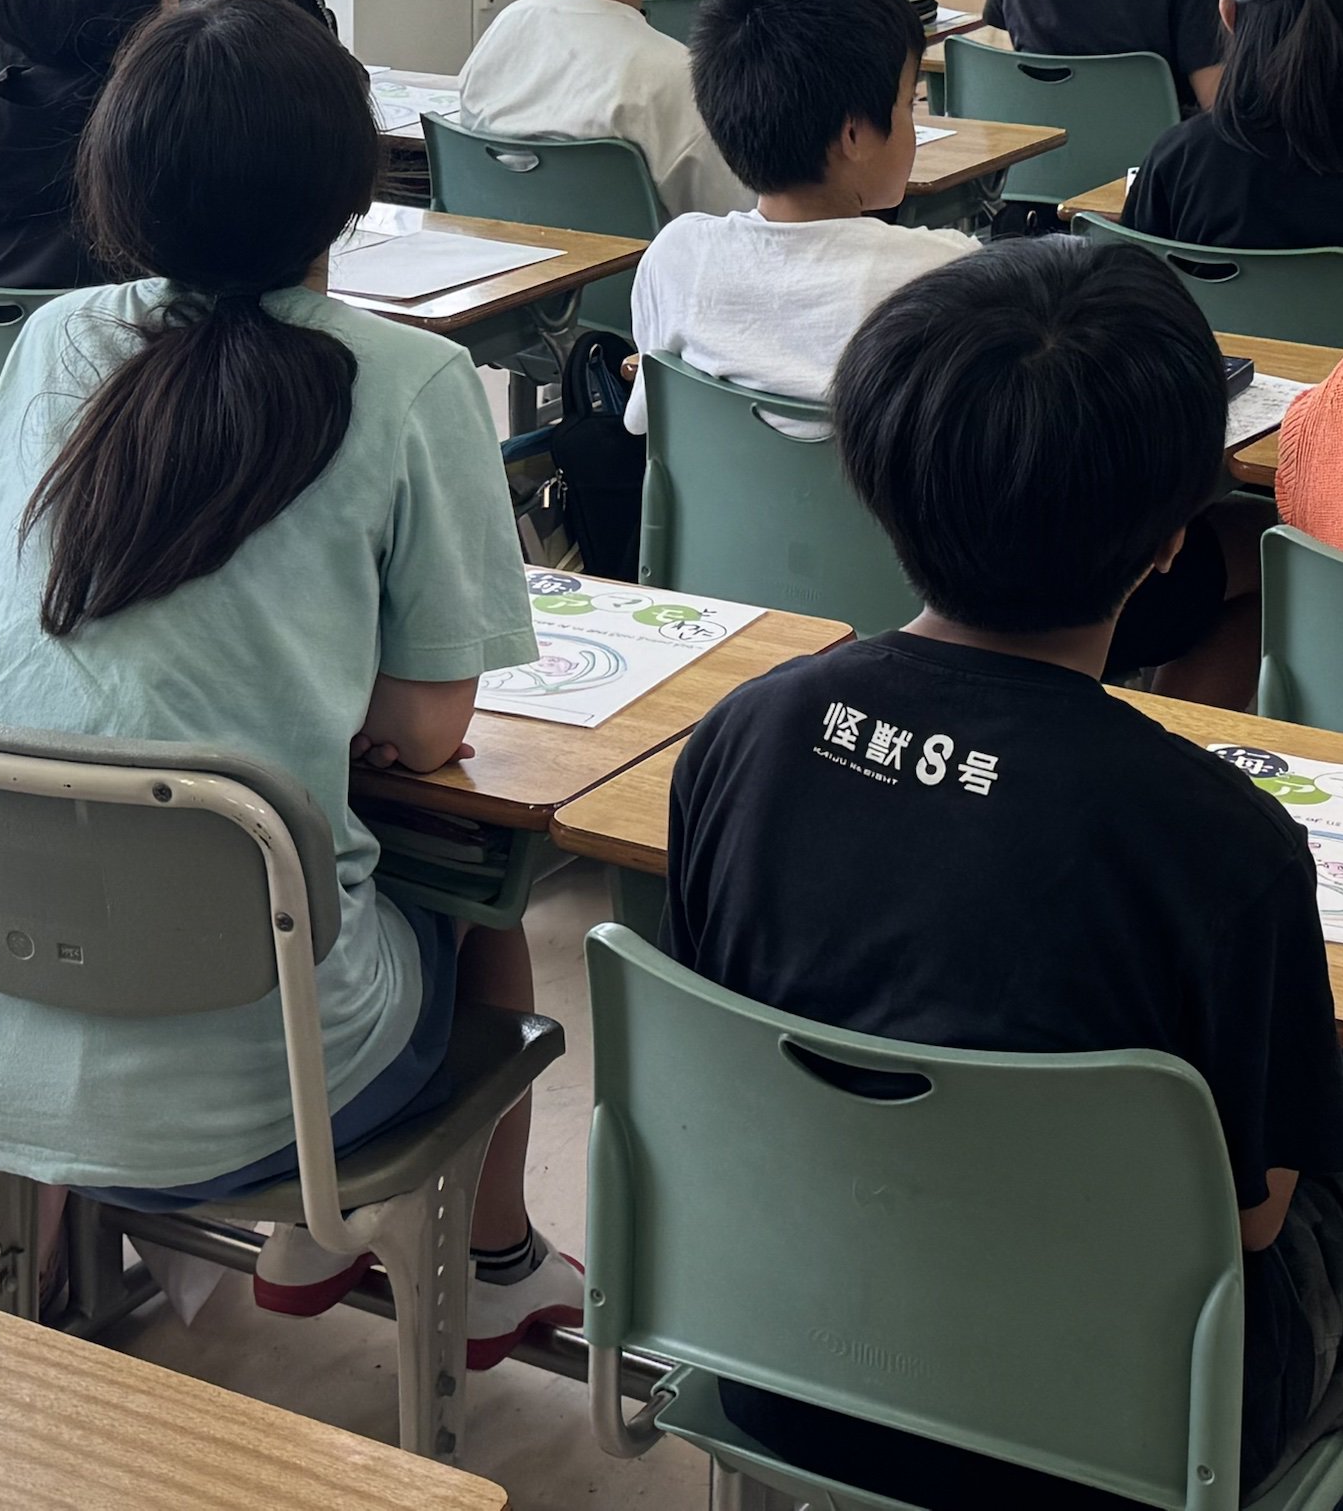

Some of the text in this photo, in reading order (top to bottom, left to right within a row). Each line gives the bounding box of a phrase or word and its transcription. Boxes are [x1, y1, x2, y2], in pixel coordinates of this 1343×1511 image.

[812, 746, 847, 766] KAIJU
[823, 701, 999, 796] 怪獣8号
